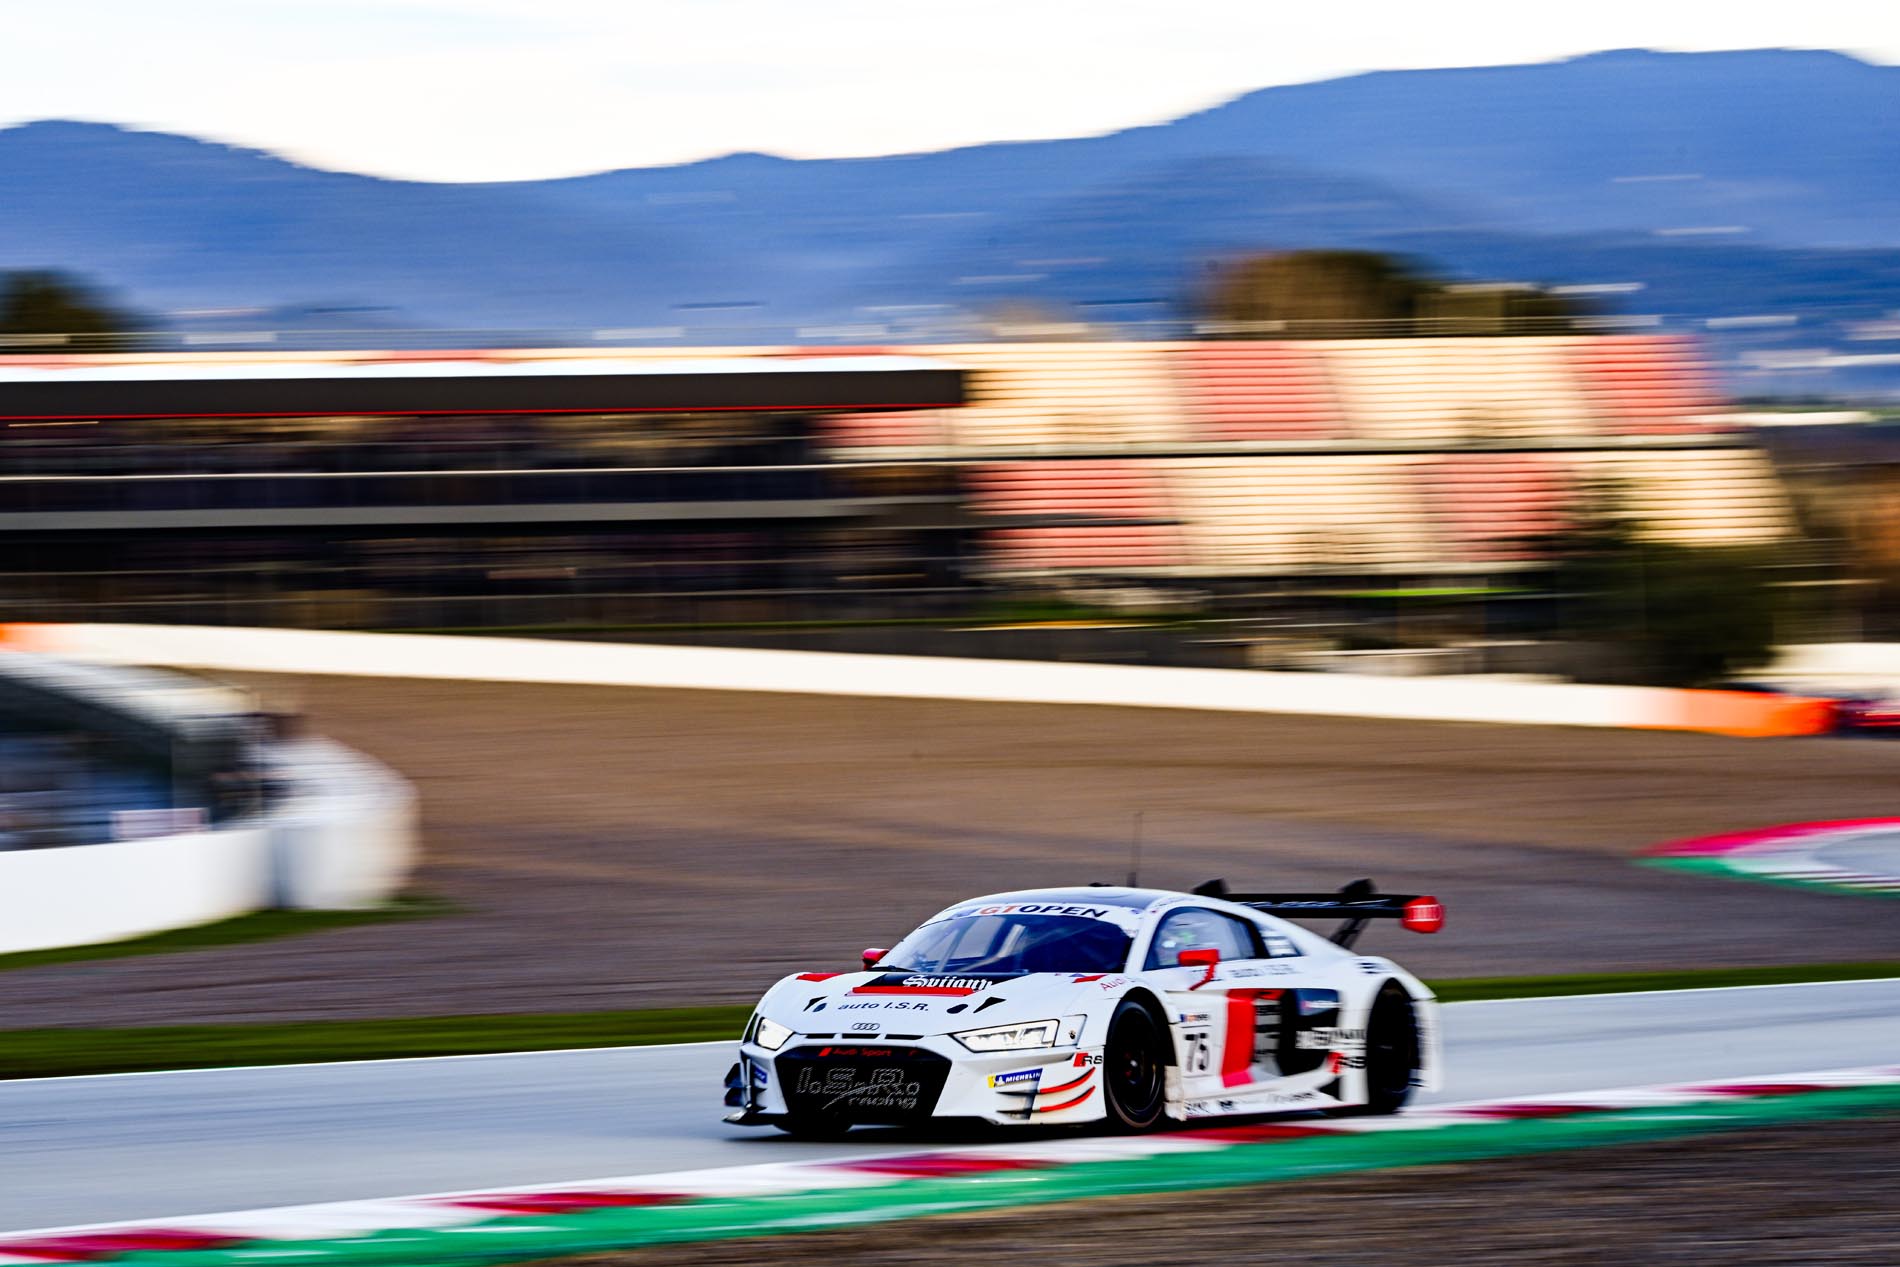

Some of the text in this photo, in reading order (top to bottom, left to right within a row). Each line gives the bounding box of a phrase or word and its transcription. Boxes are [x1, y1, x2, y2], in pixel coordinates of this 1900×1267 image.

[838, 1001, 929, 1012] auto I.S.R.
[861, 1048, 892, 1057] Sport
[1184, 1032, 1210, 1073] 75
[1005, 1072, 1041, 1083] MICHELIN
